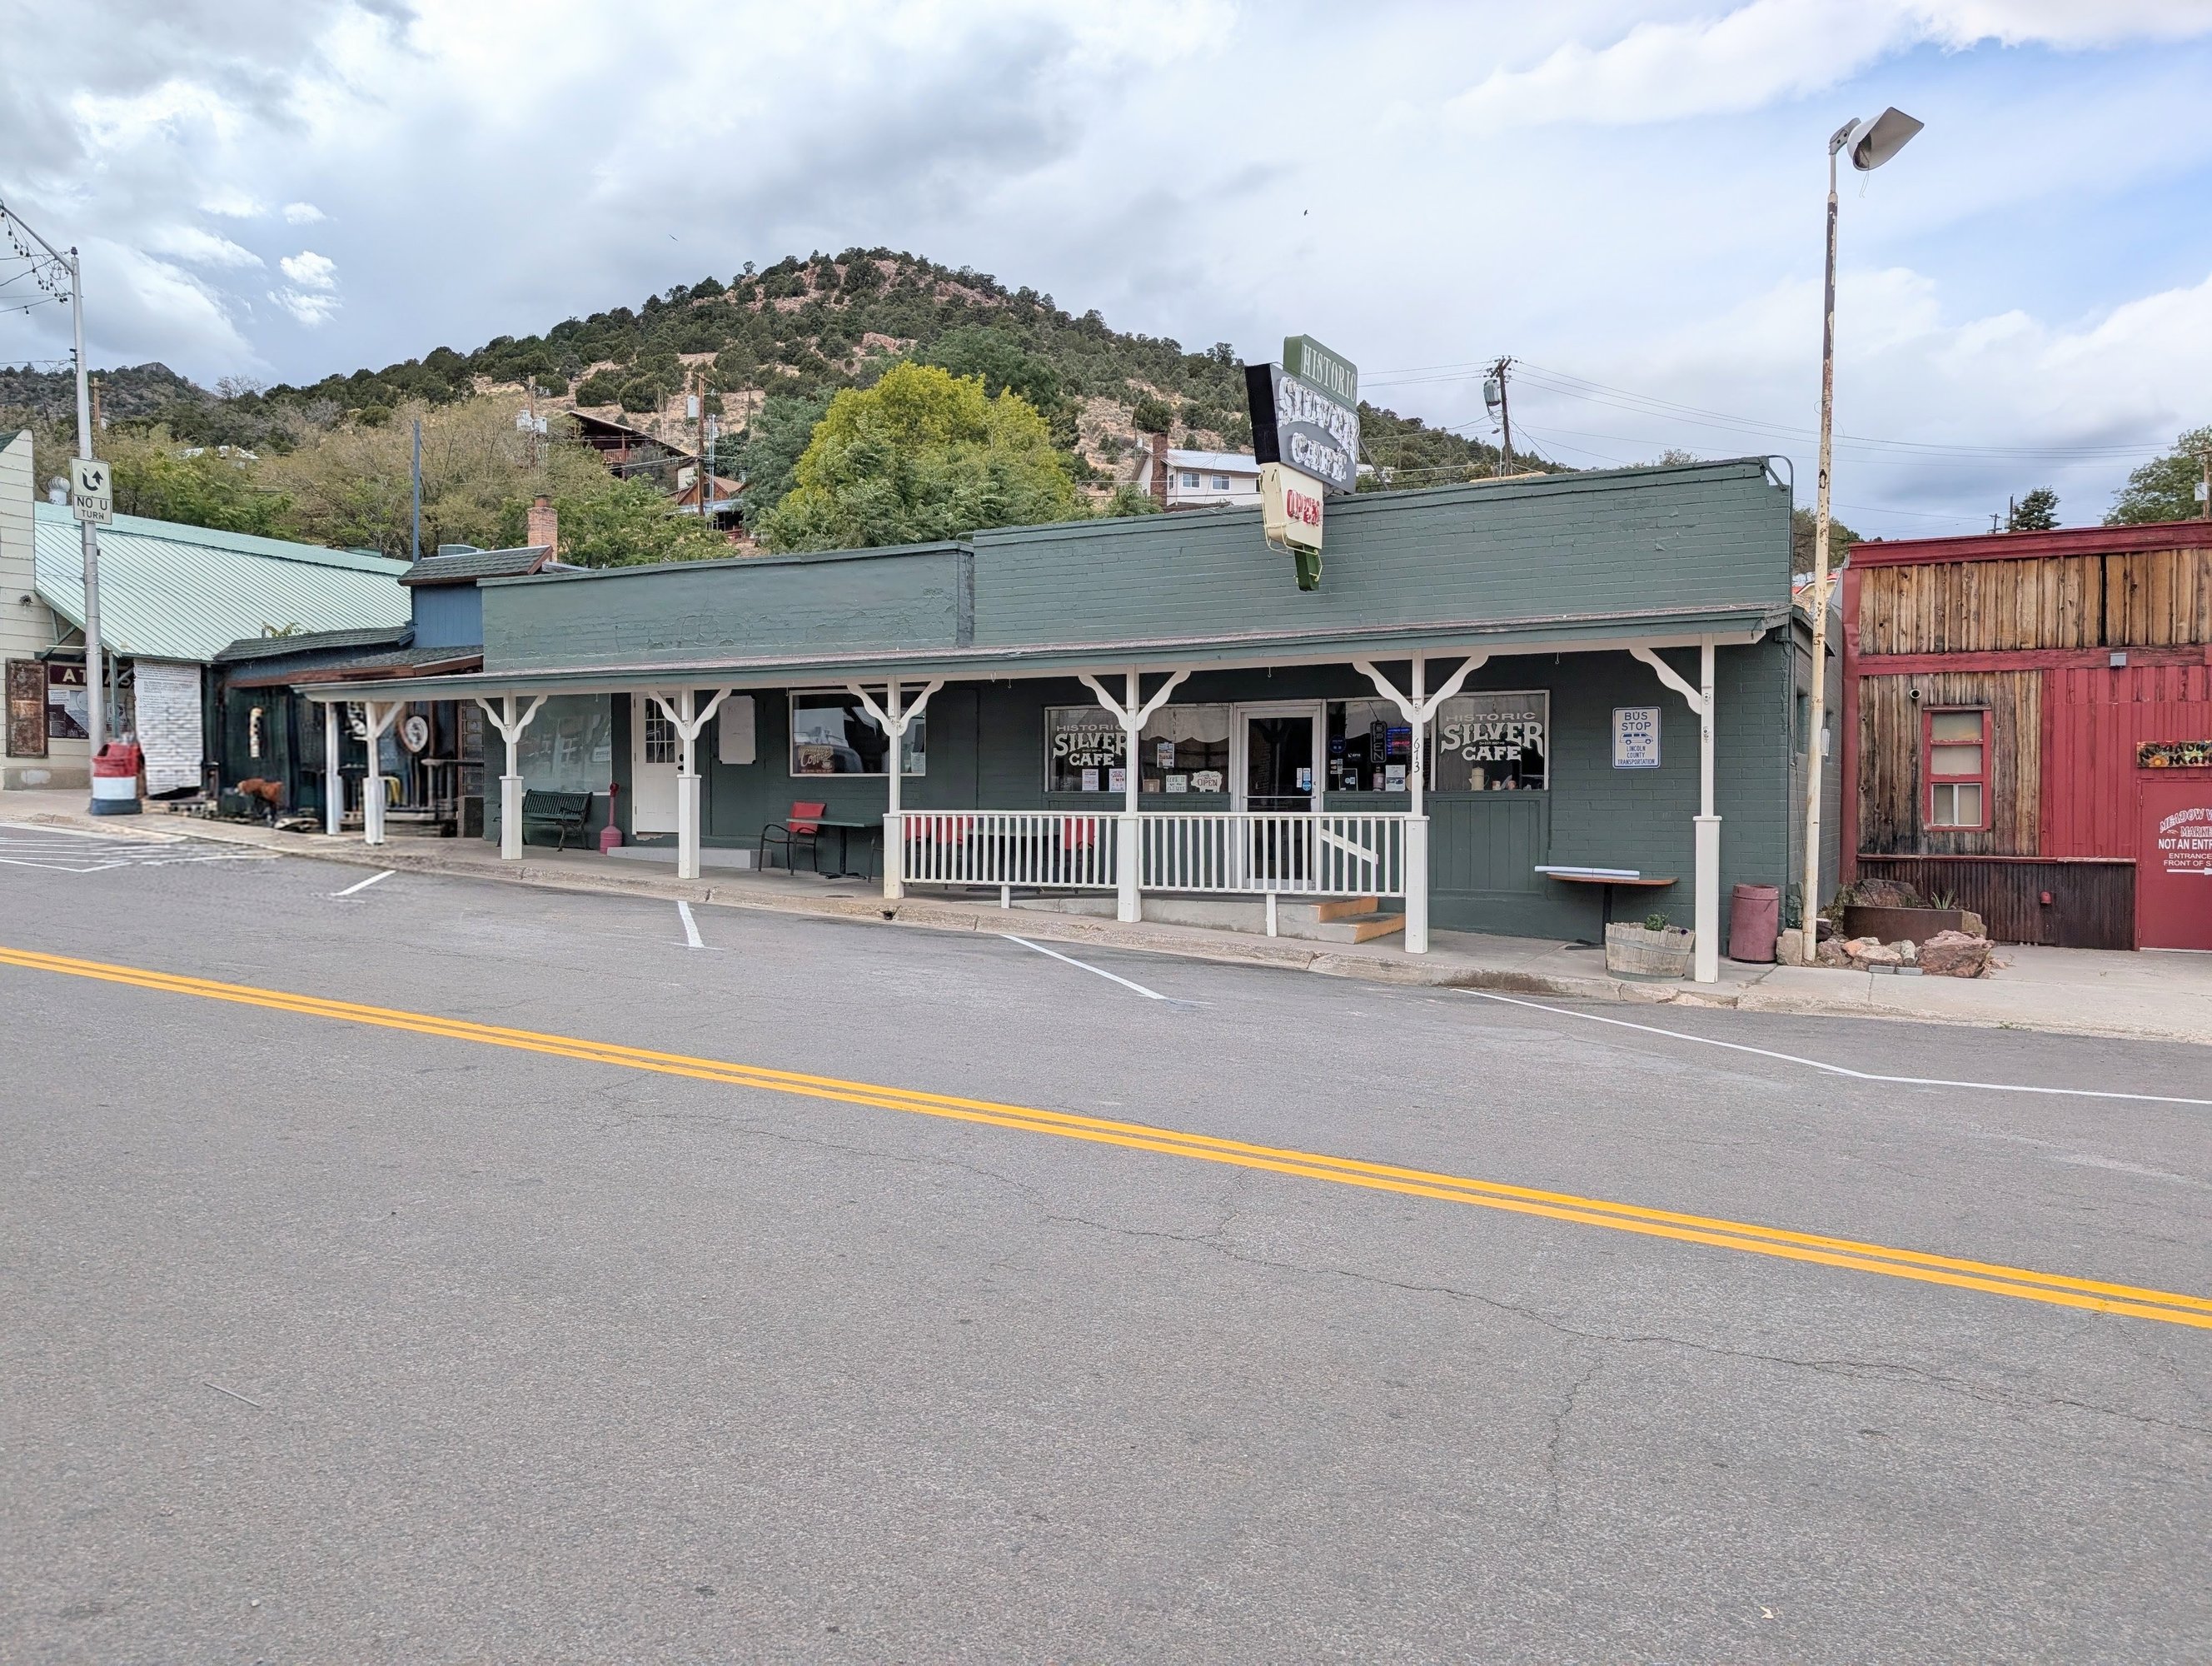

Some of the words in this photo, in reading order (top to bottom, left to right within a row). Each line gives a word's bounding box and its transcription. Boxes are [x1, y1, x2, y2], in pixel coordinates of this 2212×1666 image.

[1302, 343, 1357, 402] HISTORIC
[1278, 376, 1360, 466] SILVER
[77, 496, 93, 509] NO
[100, 500, 107, 511] U
[81, 509, 104, 521] TURN
[1446, 711, 1537, 722] HISTORIC
[1624, 711, 1648, 721] BUS
[1622, 721, 1652, 731] STOP
[1052, 733, 1127, 760] SILVER
[1440, 721, 1544, 757] SILVER
[1069, 753, 1115, 766] CAFE
[1462, 746, 1522, 761] CAFE
[2138, 741, 2210, 764] Meadow
[1197, 778, 1218, 787] OPEN
[2160, 808, 2205, 834] MEADOW
[2158, 838, 2176, 850] NOT
[2177, 838, 2190, 850] AN
